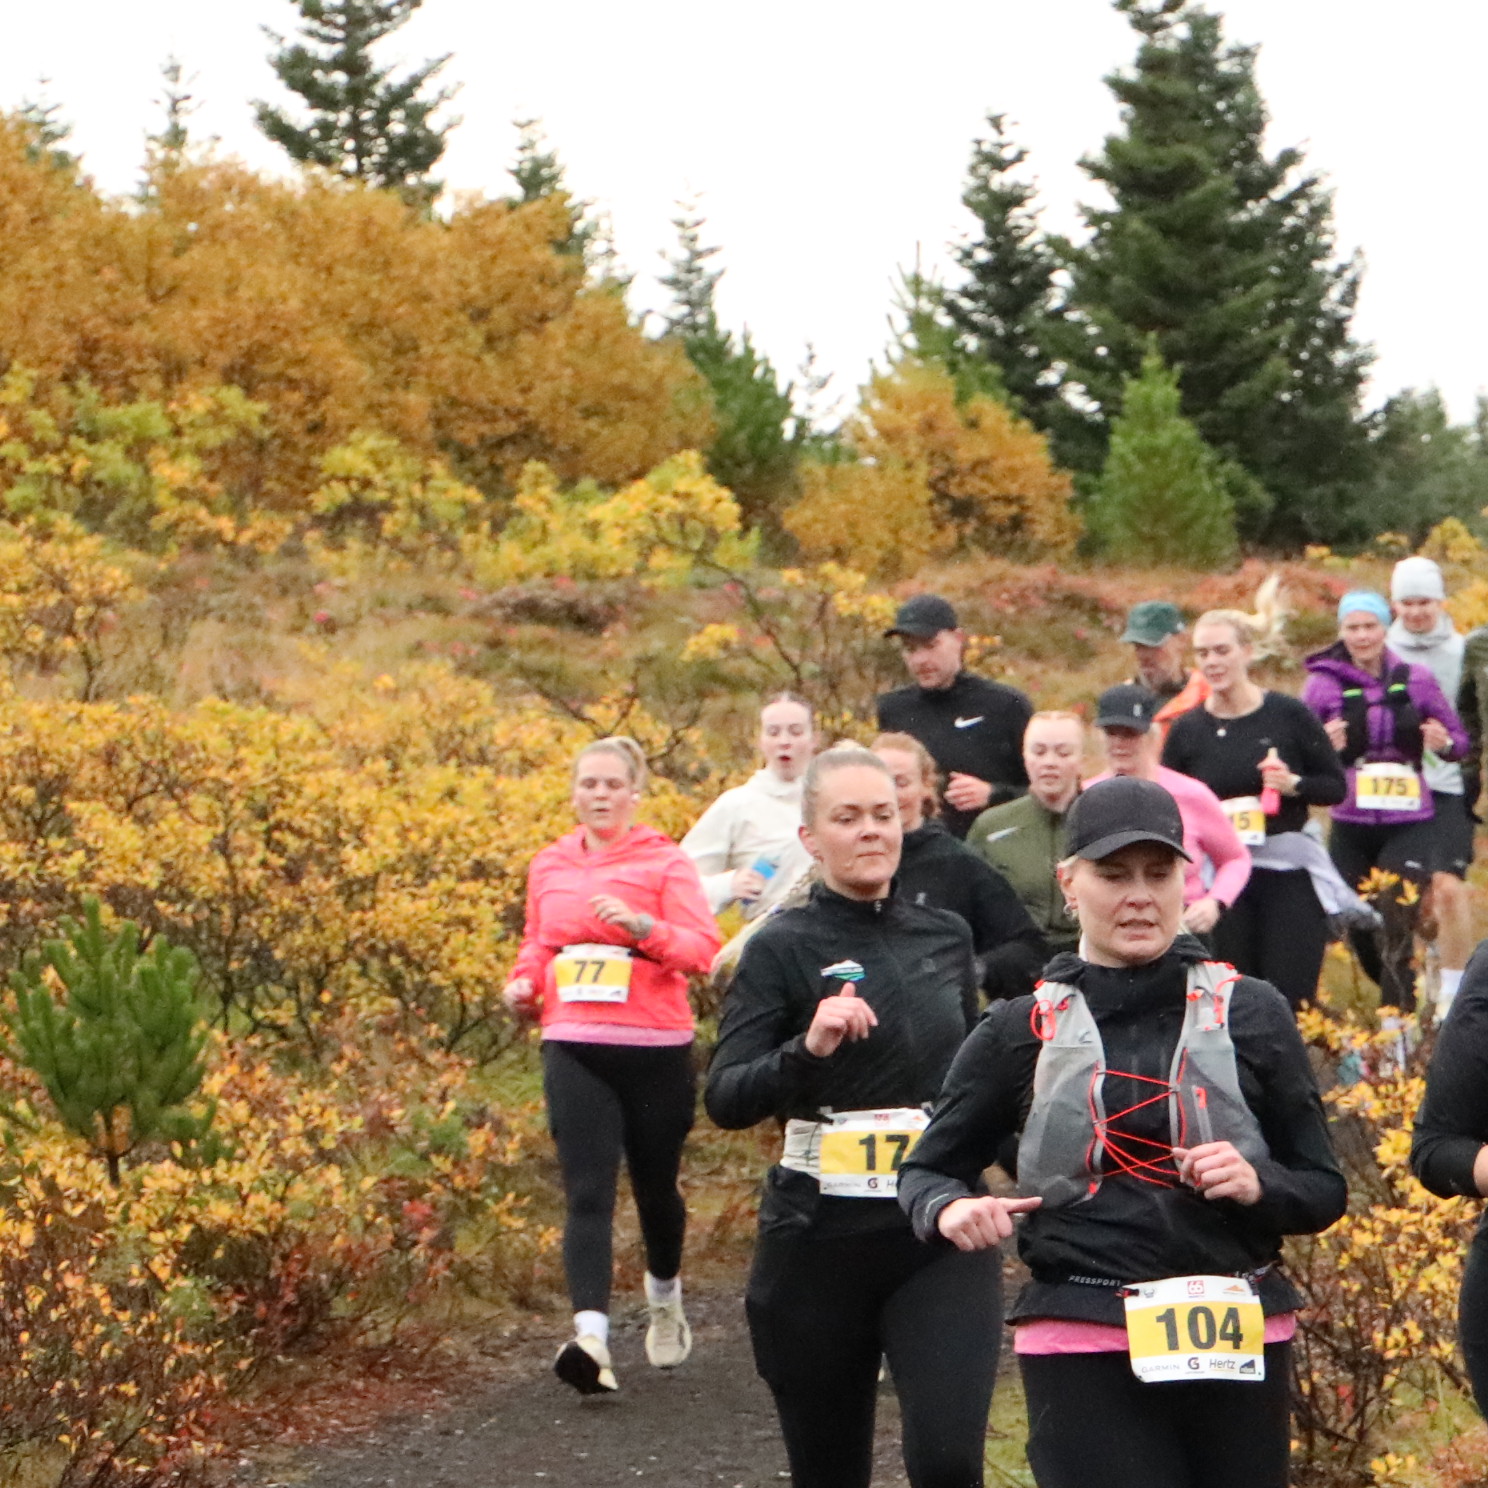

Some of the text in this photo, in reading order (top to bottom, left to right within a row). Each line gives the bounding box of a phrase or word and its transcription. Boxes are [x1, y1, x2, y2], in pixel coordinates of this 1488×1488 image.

[1372, 777, 1408, 796] 175
[574, 960, 607, 983] 77
[1155, 1306, 1244, 1351] 104
[1209, 1359, 1236, 1370] Hertz
